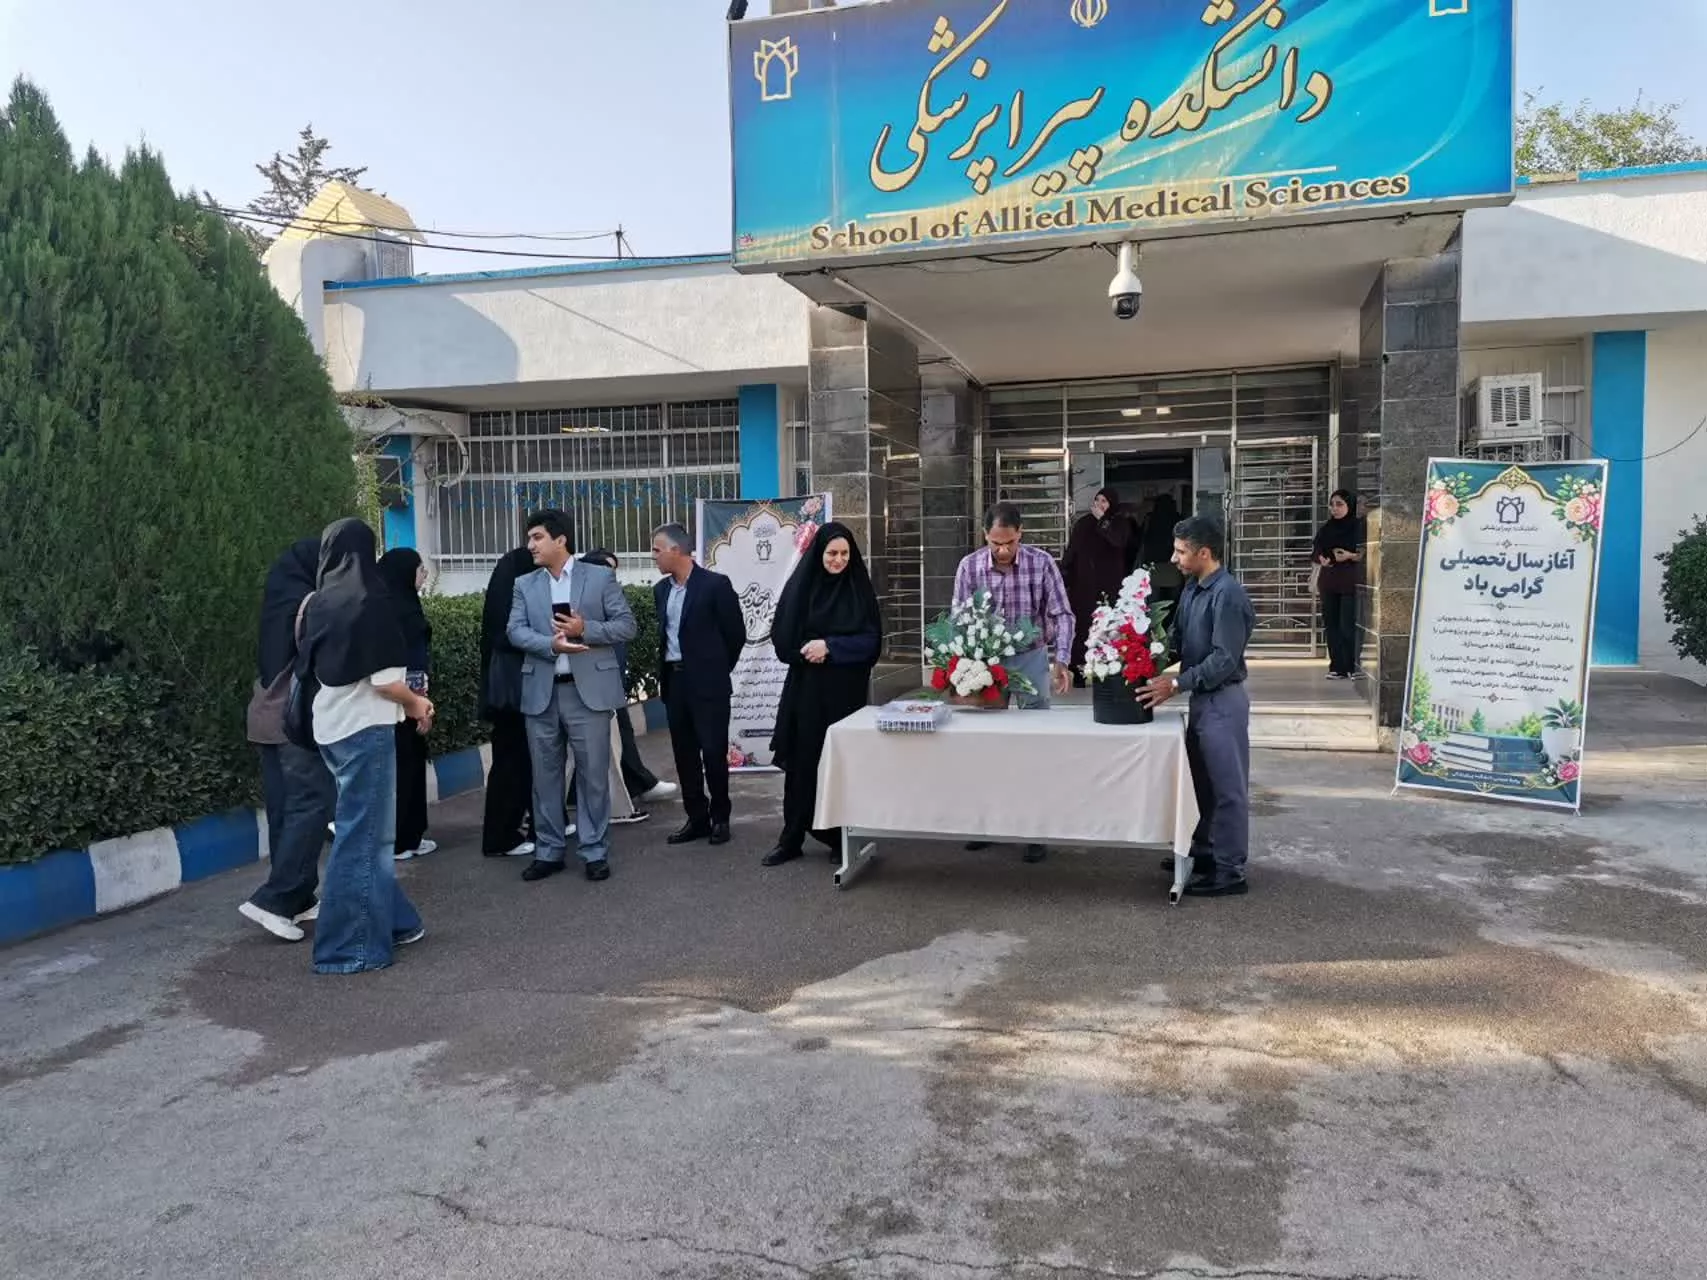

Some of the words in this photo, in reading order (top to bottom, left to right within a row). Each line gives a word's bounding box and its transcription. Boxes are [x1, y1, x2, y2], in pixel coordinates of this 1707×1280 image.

[811, 216, 920, 250] School
[930, 211, 968, 239] of
[975, 200, 1077, 234] Allied
[1086, 183, 1233, 223] Medical
[1245, 174, 1407, 208] Sciences
[1440, 549, 1507, 570] تحصیلی
[1506, 552, 1544, 572] سال
[1543, 549, 1576, 573] آغاز
[1464, 574, 1488, 595] باد
[1491, 576, 1545, 599] گرامی
